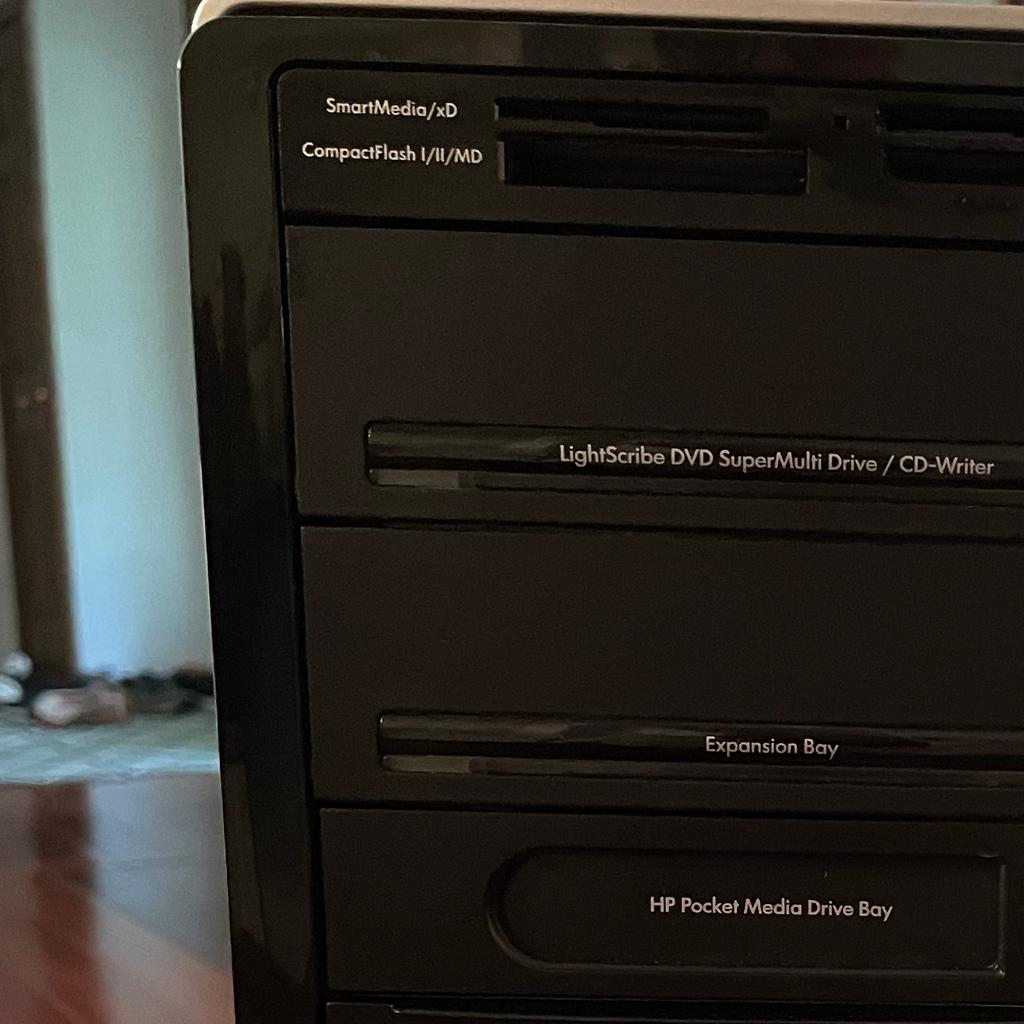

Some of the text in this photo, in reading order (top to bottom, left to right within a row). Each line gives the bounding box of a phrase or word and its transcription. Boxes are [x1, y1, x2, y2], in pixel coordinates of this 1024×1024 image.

[326, 97, 458, 120] SmartMedia/xD
[301, 141, 417, 163] CompactFlash
[559, 444, 666, 469] LightScribe
[670, 447, 714, 466] DVD
[718, 450, 823, 473] SuperMulti
[828, 453, 878, 472] Drive
[899, 455, 995, 476] CD-Writer
[705, 735, 840, 760] Expansion Bay
[650, 896, 894, 922] HP Pocket Media Drive Bay
